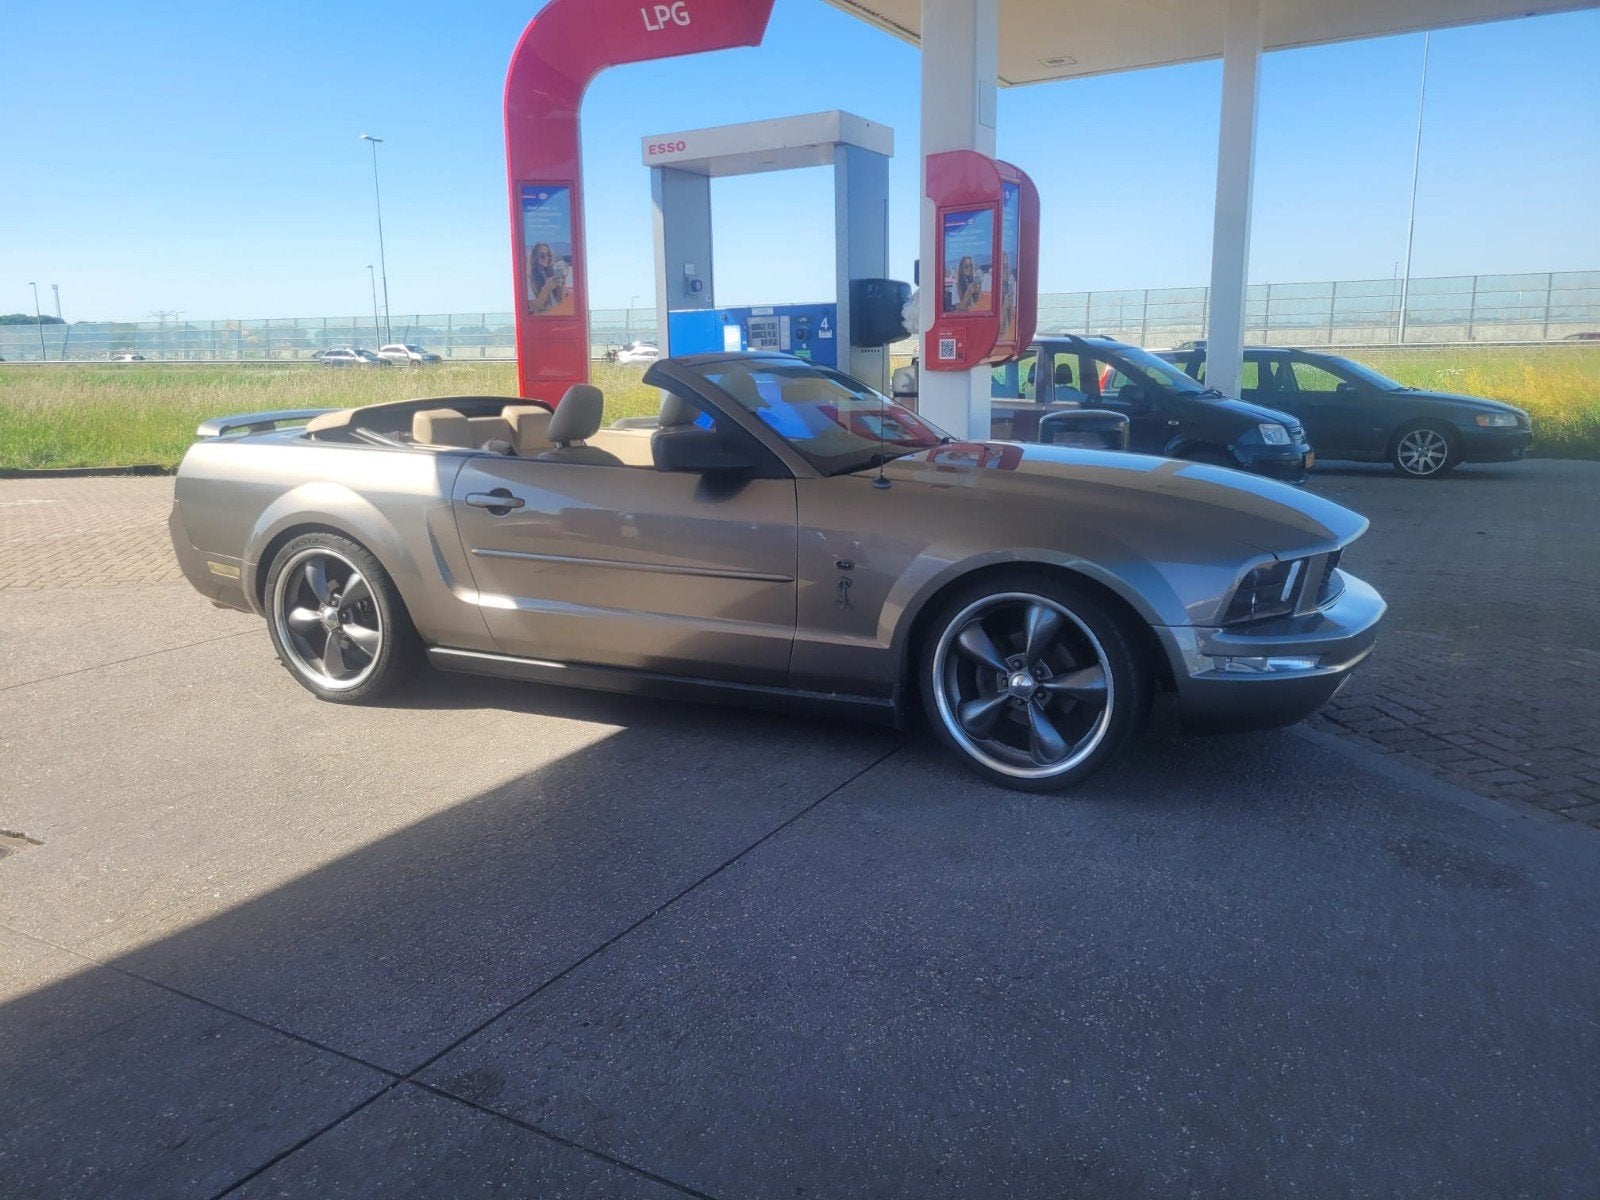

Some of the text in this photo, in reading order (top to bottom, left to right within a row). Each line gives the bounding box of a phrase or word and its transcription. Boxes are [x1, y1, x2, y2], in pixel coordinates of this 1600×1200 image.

[640, 1, 691, 31] LPG
[648, 140, 687, 155] ESSO
[820, 317, 829, 330] 4
